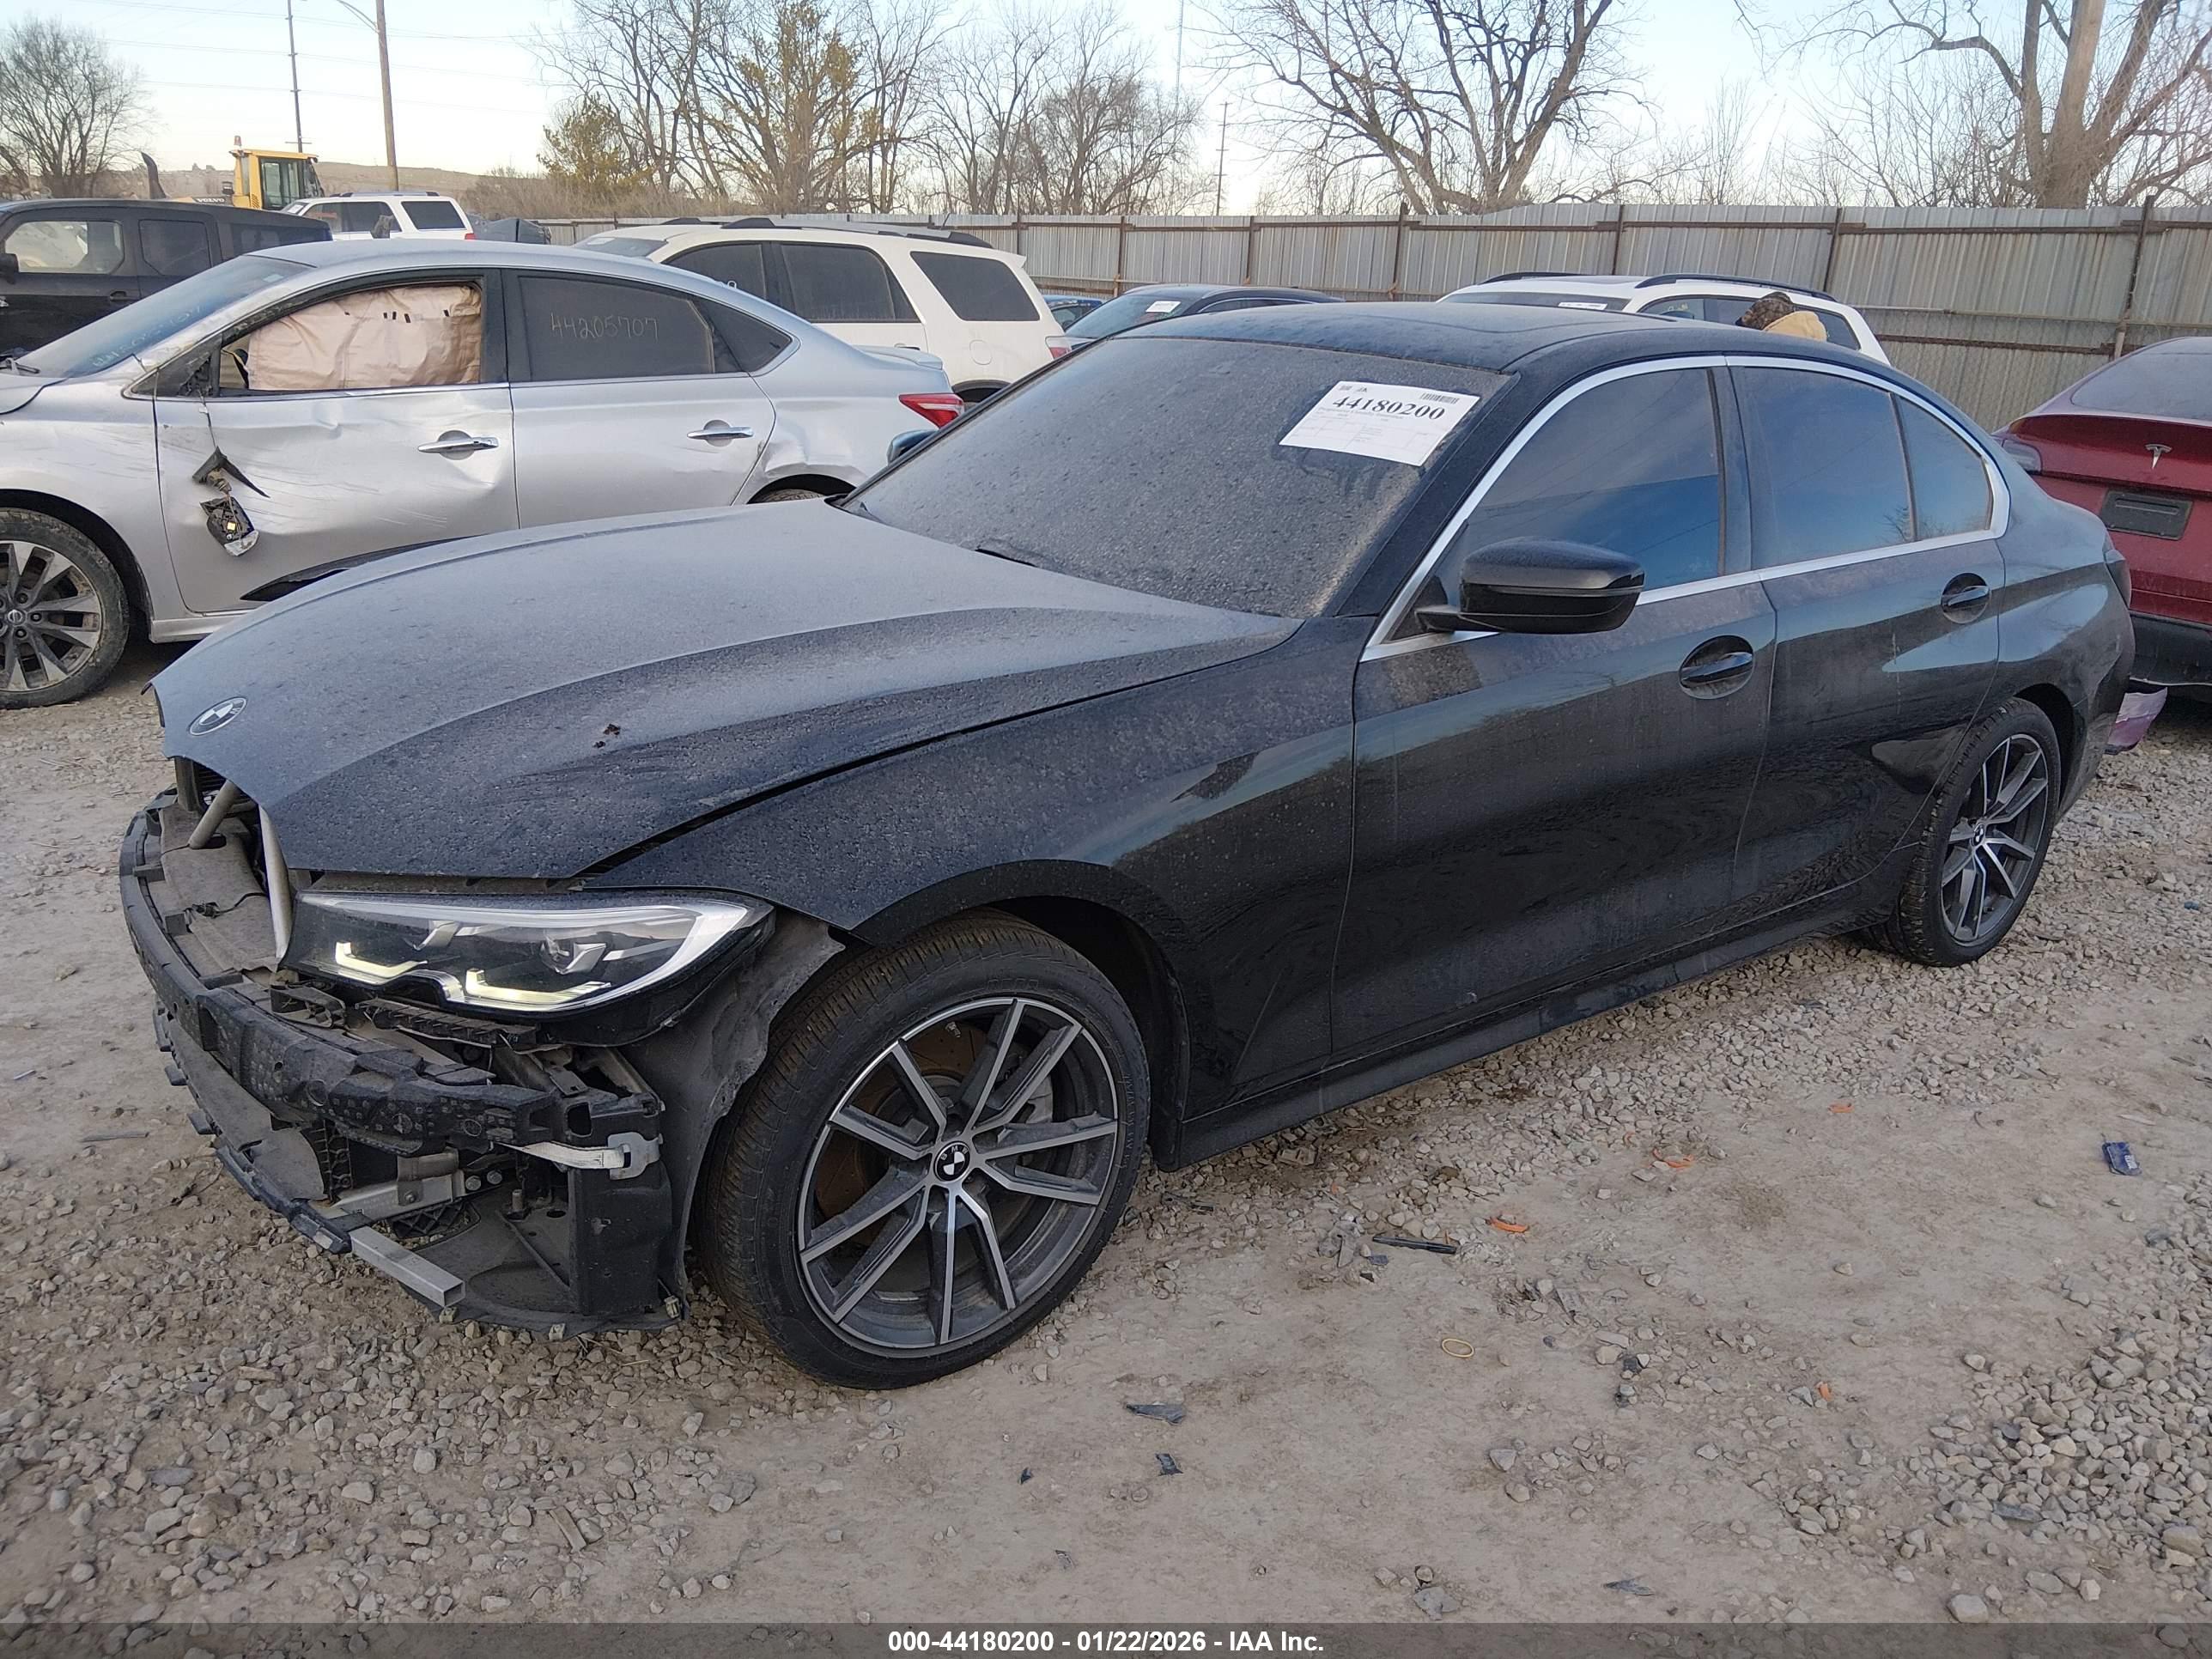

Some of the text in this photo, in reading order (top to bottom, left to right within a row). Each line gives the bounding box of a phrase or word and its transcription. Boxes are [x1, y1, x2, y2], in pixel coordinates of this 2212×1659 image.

[550, 313, 659, 341] 44205707
[1332, 396, 1445, 420] 44180200
[940, 1145, 969, 1161] BMW
